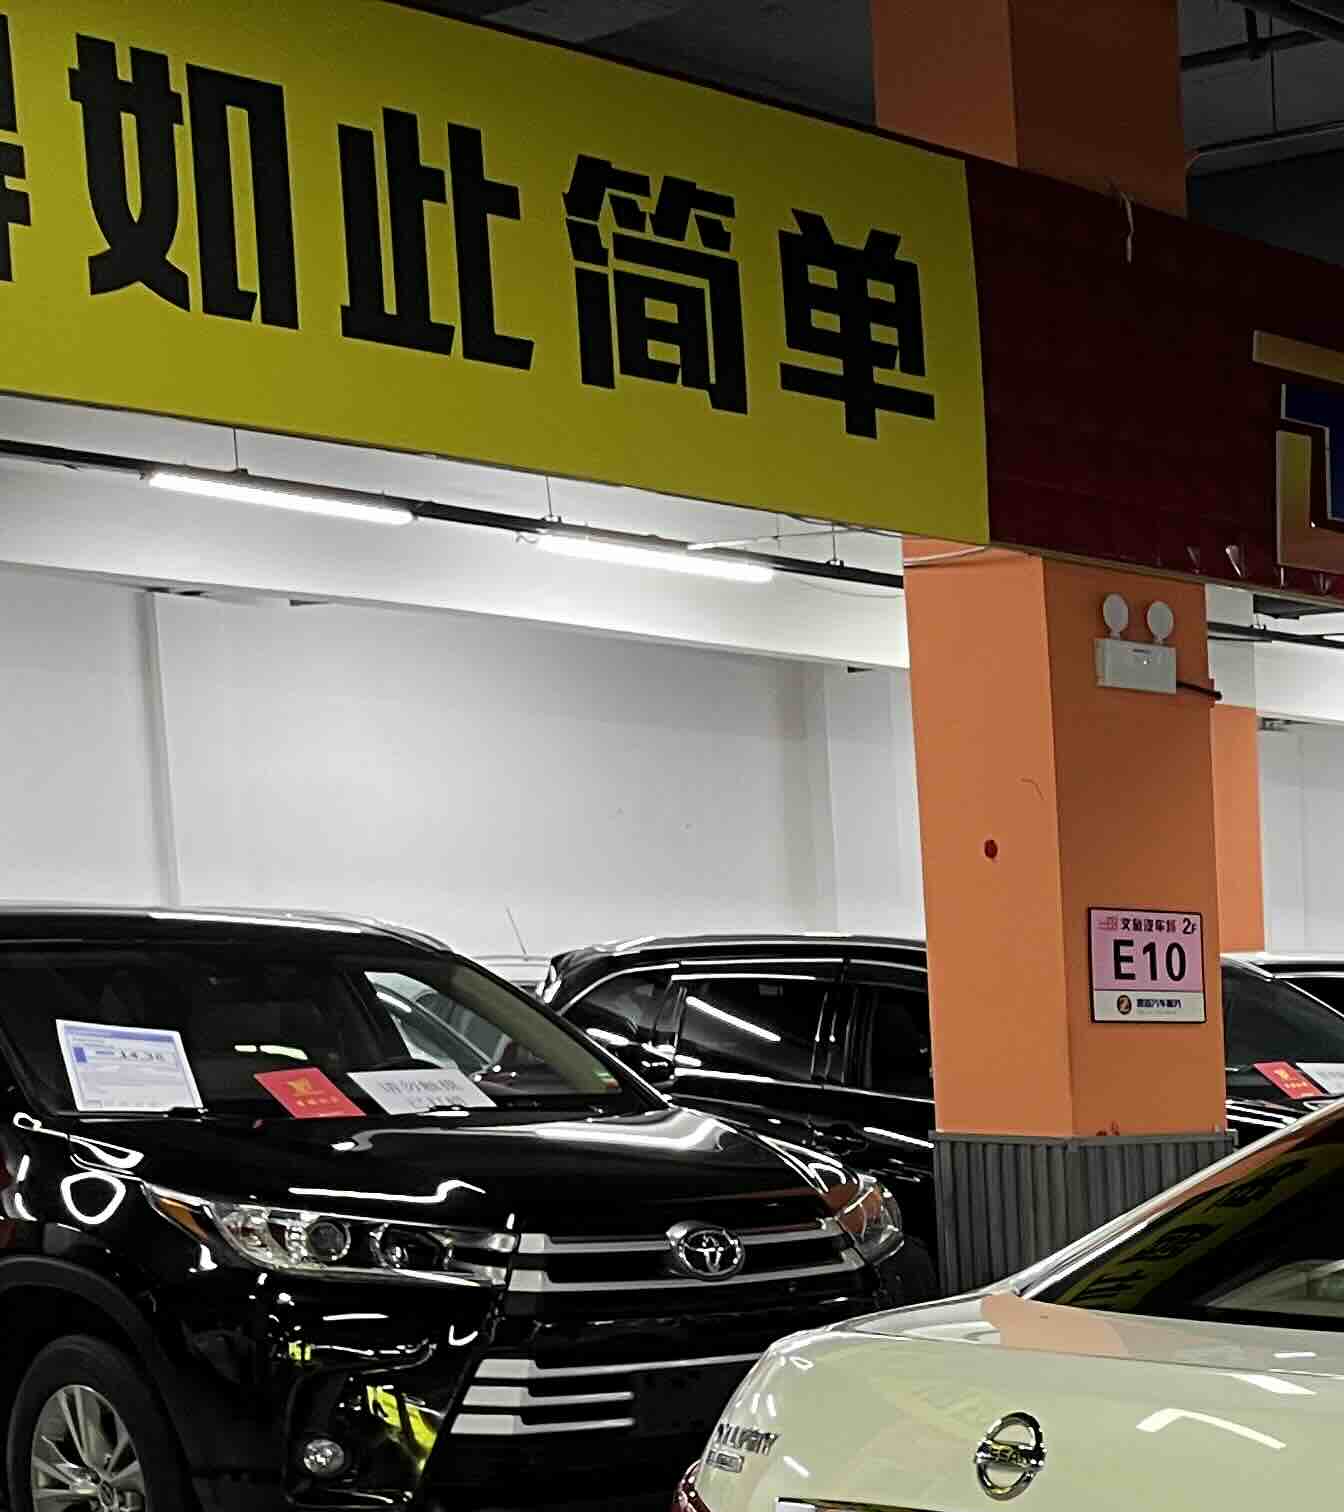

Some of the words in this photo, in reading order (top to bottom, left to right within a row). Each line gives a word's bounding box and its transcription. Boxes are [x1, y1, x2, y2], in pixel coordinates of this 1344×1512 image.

[0, 12, 936, 440] 如此简单
[1113, 939, 1187, 982] E10
